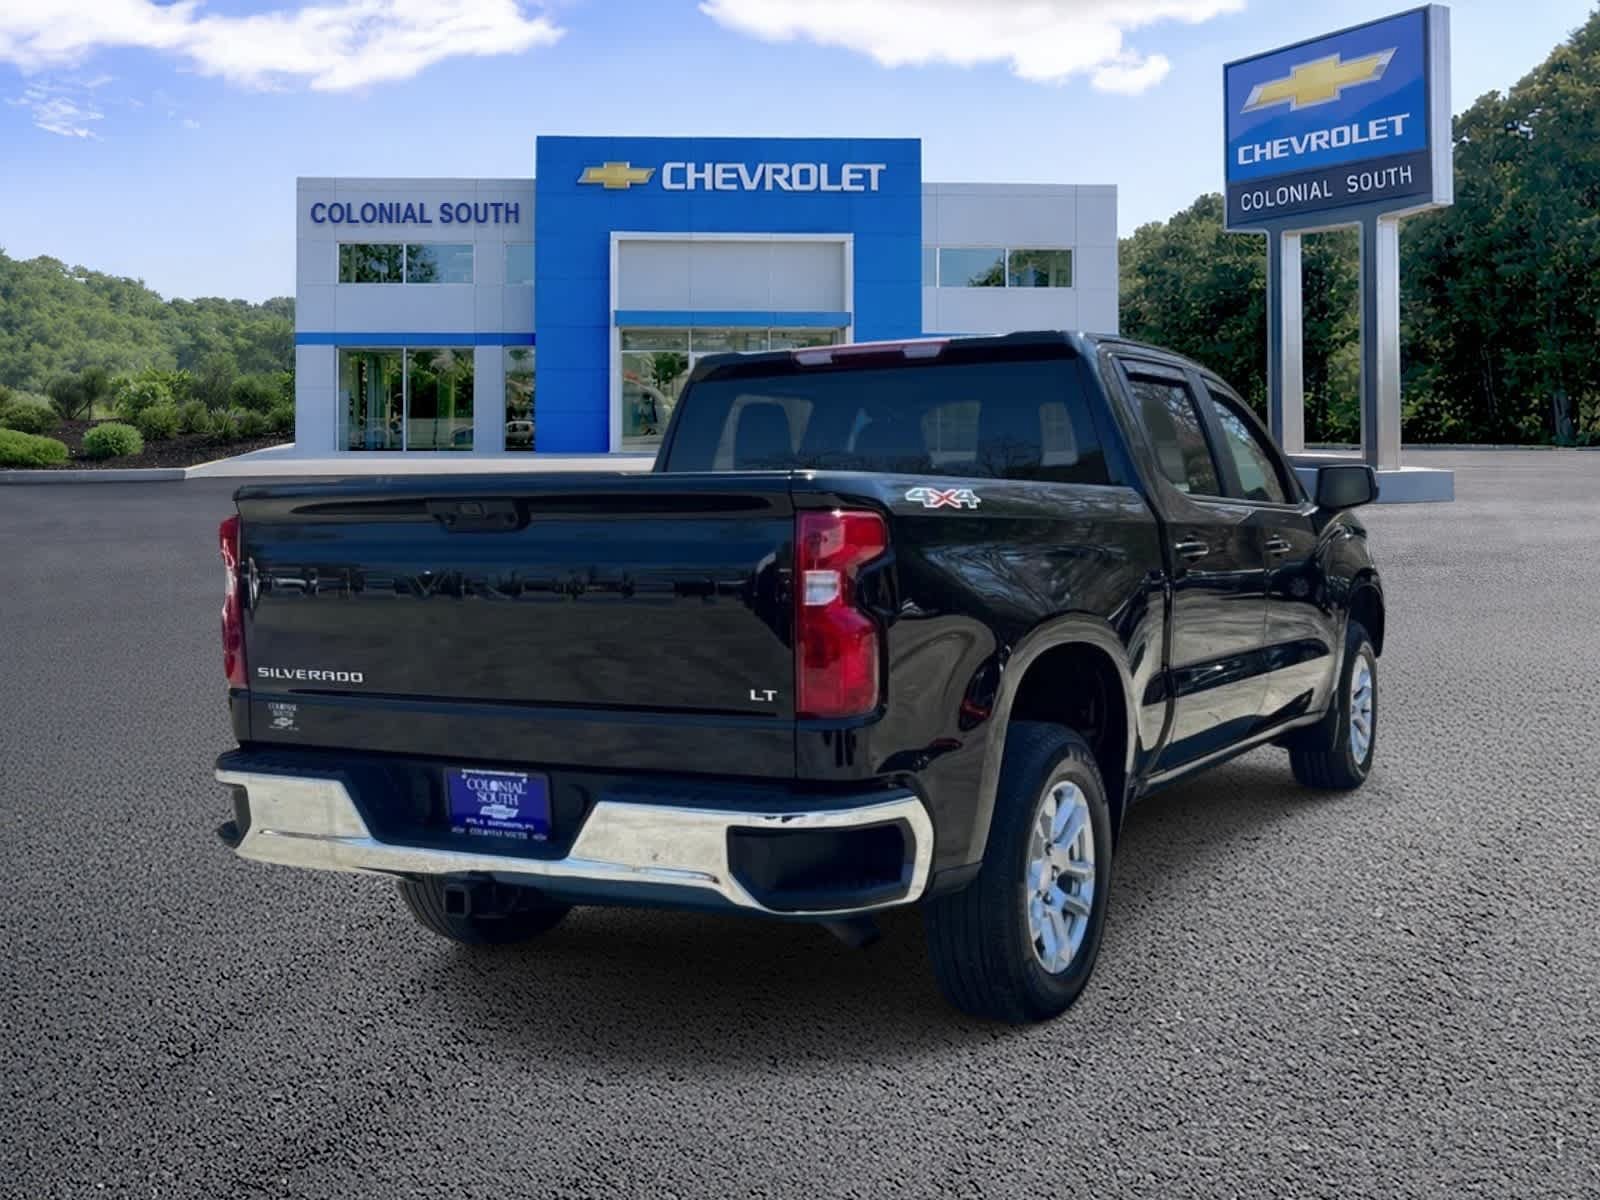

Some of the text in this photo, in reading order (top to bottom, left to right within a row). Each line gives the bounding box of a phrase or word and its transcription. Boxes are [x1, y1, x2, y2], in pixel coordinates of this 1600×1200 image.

[1237, 113, 1410, 165] CHEVROLET
[661, 161, 887, 192] CHEVROLET
[1241, 165, 1413, 212] COLONIAL SOUTH
[310, 202, 520, 224] COLONIAL SOUTH
[257, 667, 364, 683] SILVERADO
[750, 689, 778, 702] LT
[466, 778, 527, 795] COLONIAL
[477, 791, 519, 806] SOUTH
